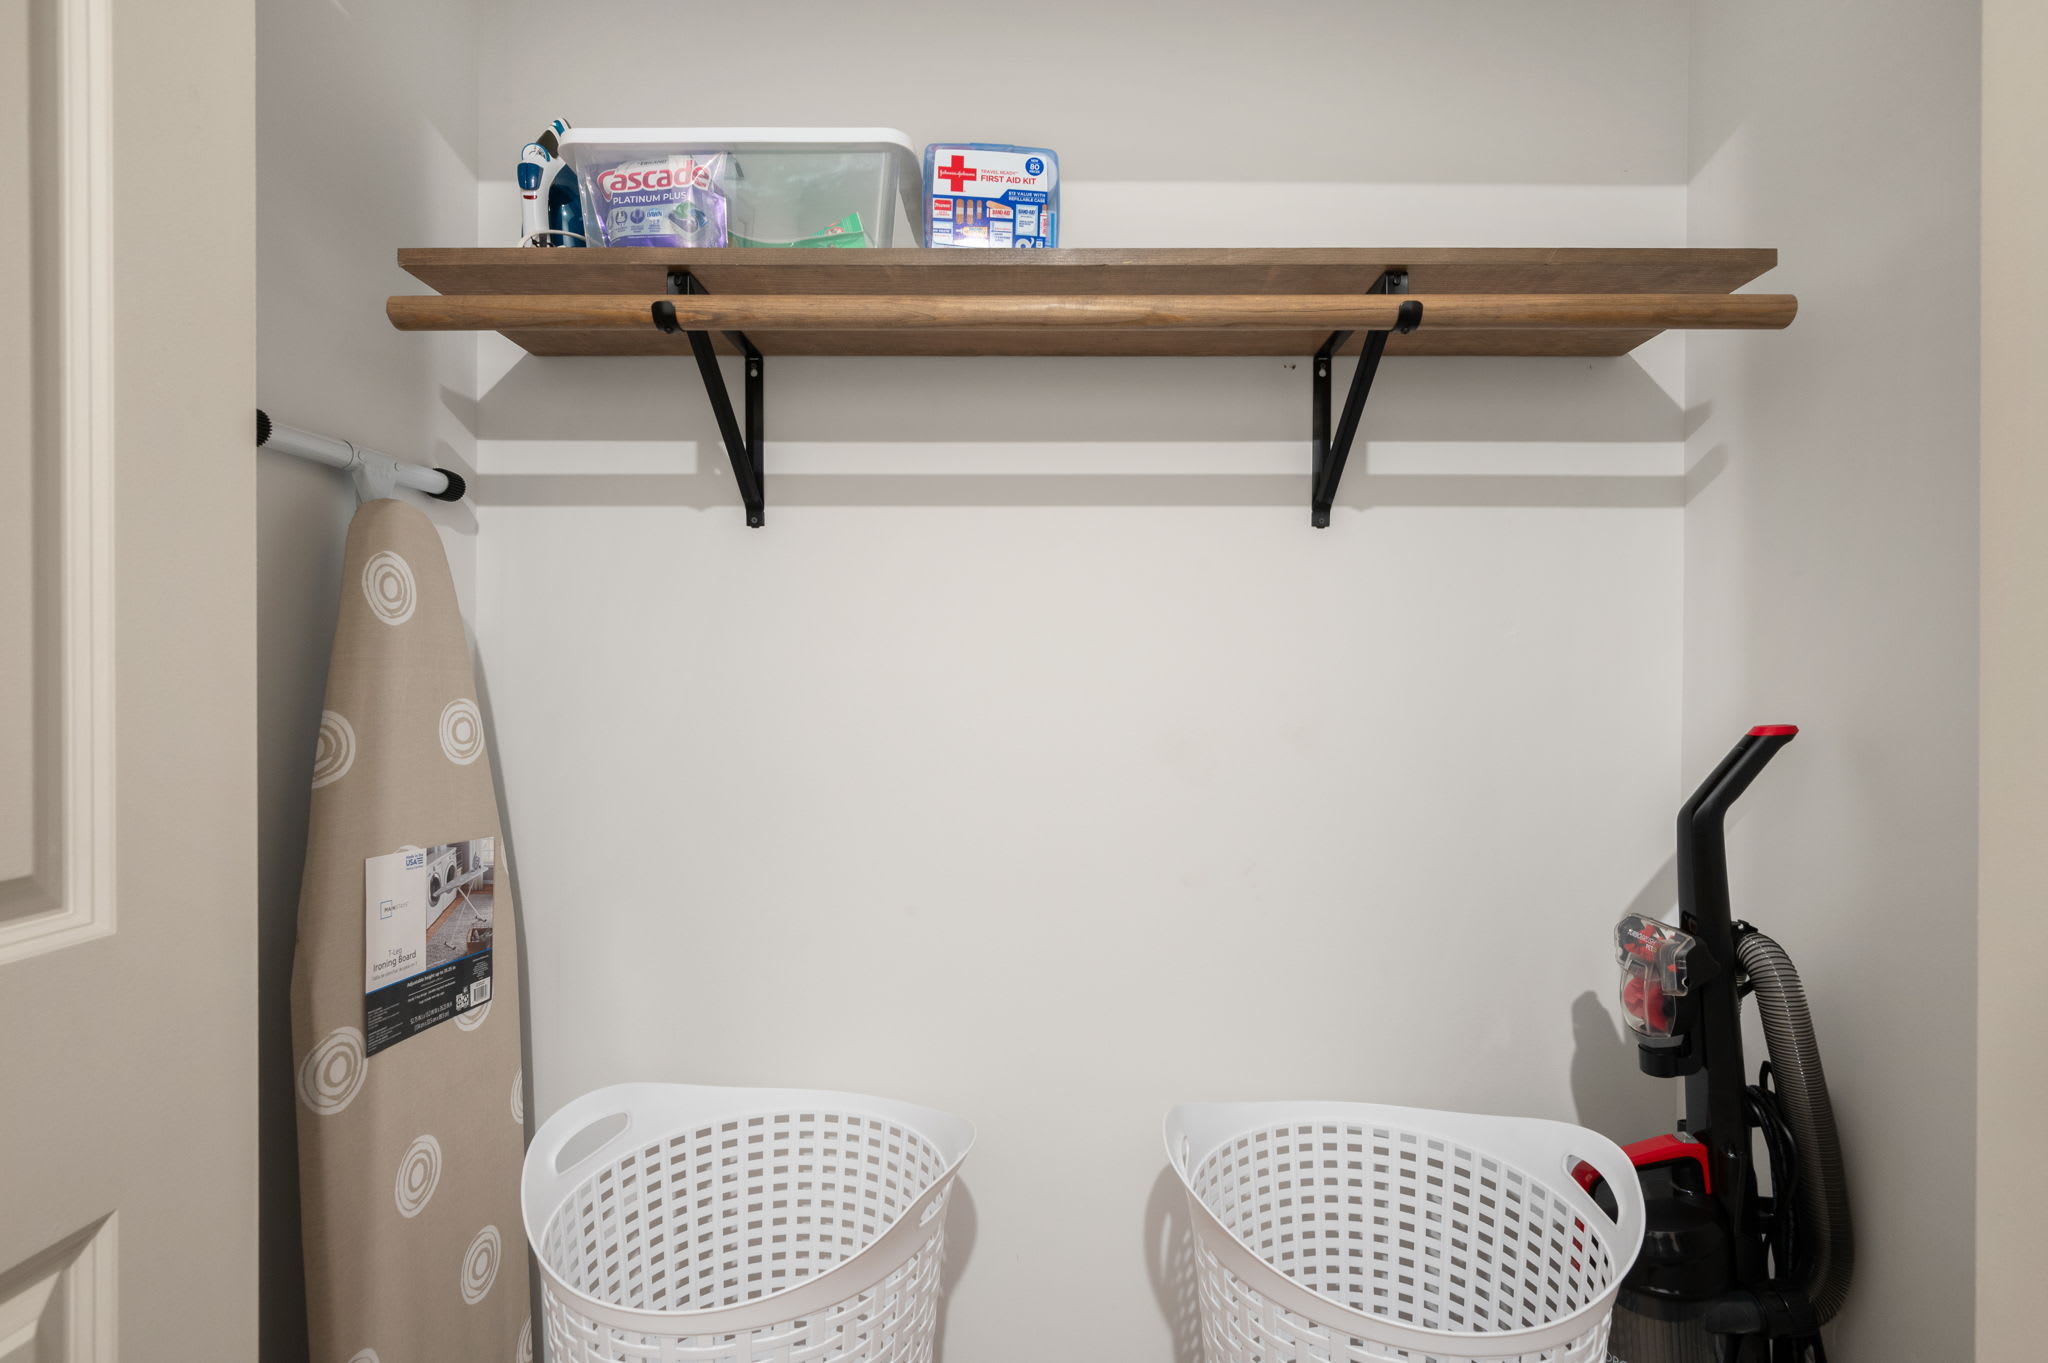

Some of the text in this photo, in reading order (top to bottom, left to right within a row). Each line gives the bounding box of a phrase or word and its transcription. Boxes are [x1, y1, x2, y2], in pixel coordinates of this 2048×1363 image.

[1029, 163, 1040, 171] 80
[597, 159, 711, 201] Cascade
[980, 174, 1037, 185] FIRST AID KIT
[613, 191, 688, 205] PLATINUM PLUS
[406, 858, 418, 866] USA
[373, 957, 397, 972] Ironing
[398, 950, 417, 964] Board
